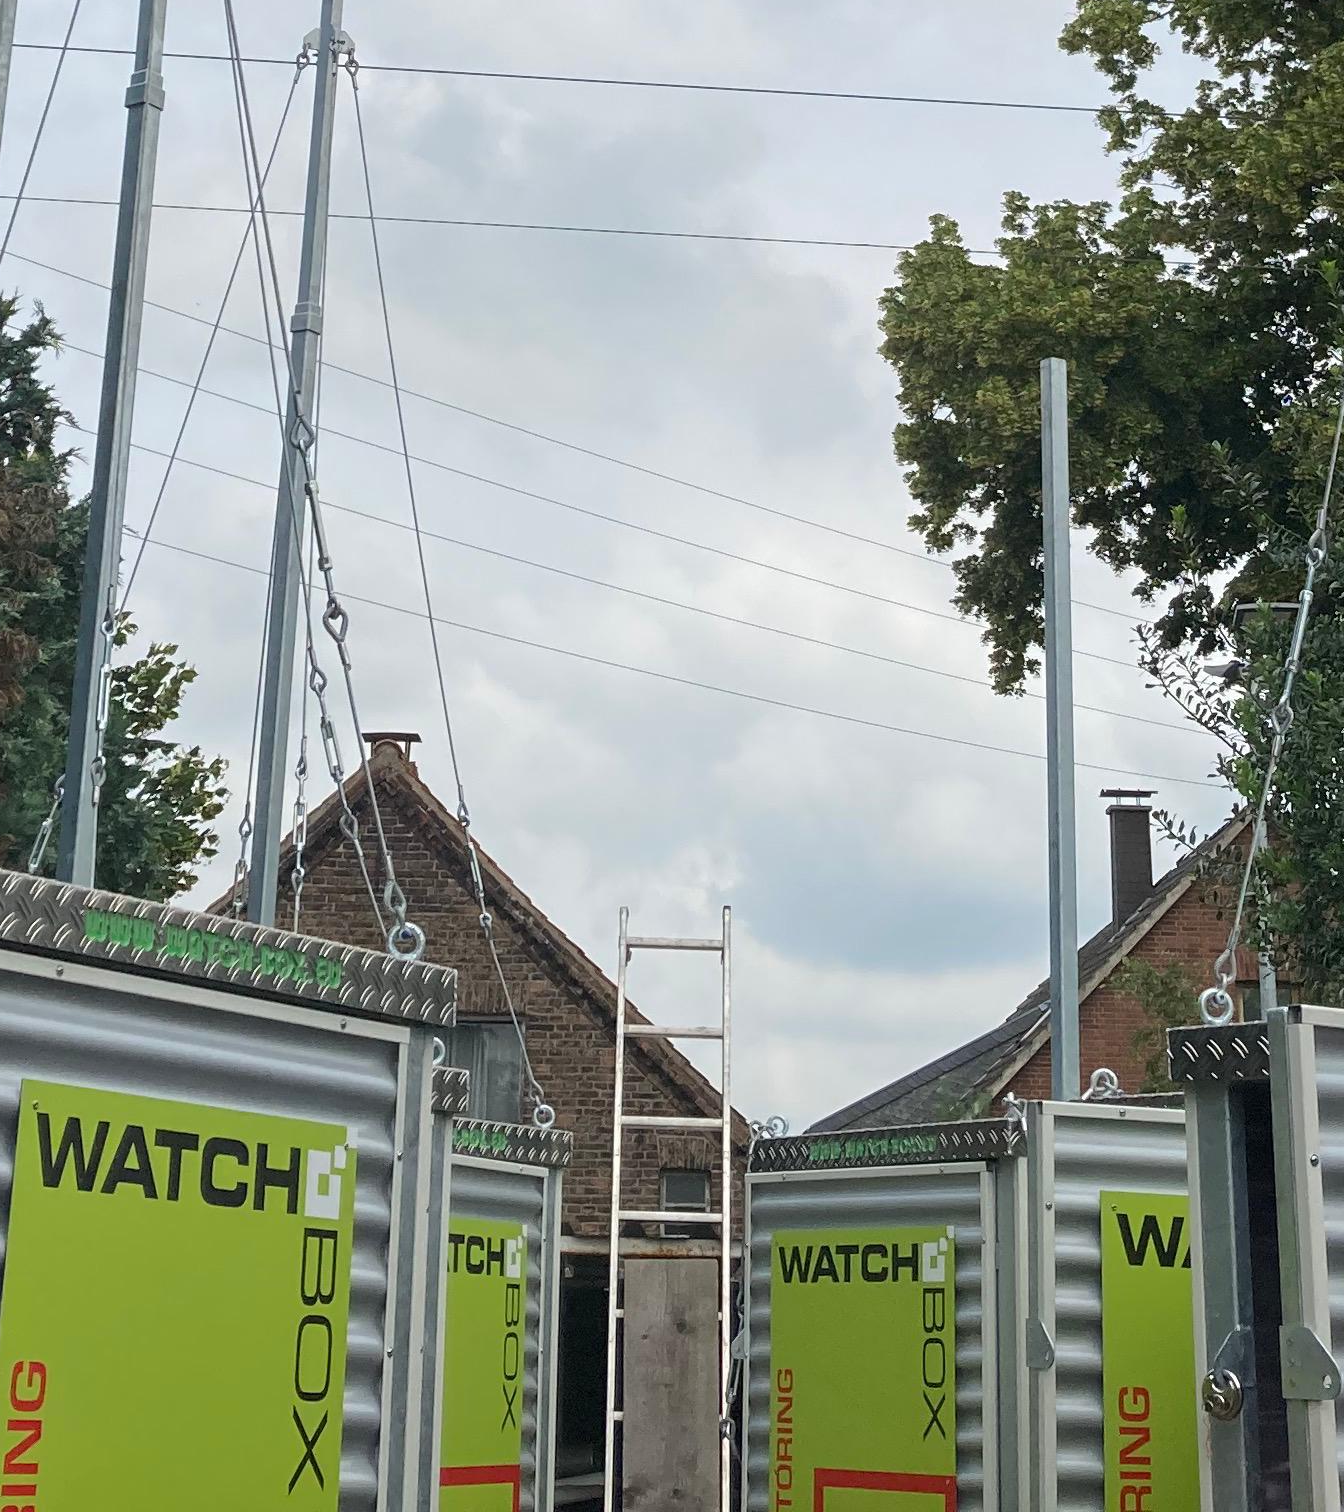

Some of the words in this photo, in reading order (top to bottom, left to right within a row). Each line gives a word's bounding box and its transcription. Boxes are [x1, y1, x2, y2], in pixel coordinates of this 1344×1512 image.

[36, 1111, 302, 1215] WATCH
[446, 1232, 505, 1277] TCH
[777, 1241, 921, 1285] WATCH
[1115, 1212, 1192, 1269] W
[287, 1227, 339, 1496] BOX
[500, 1283, 521, 1433] BOX
[921, 1287, 948, 1441] BOX
[0, 1360, 47, 1512] ING
